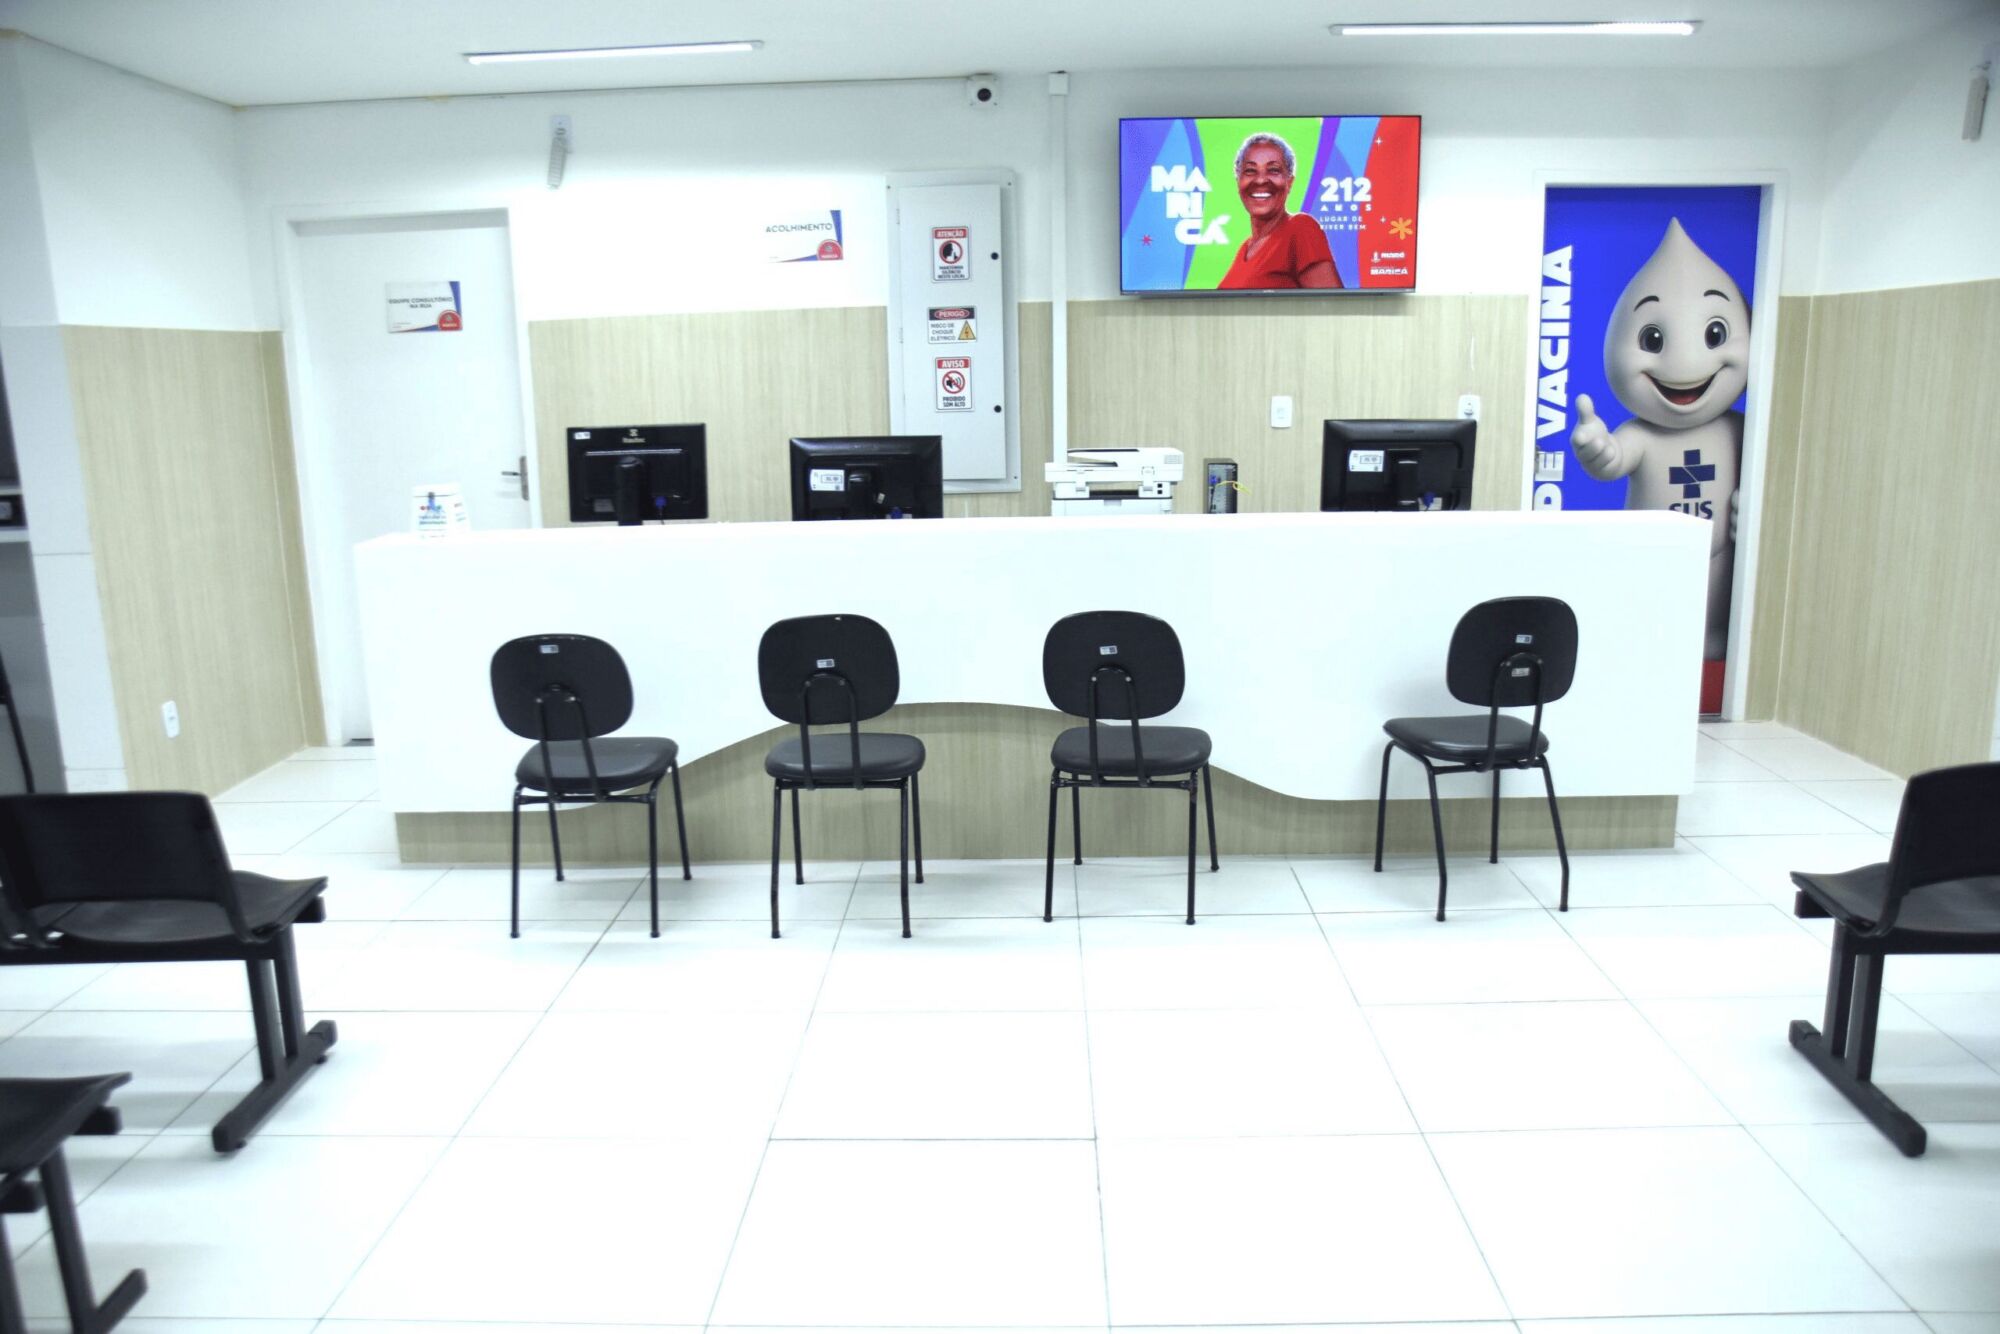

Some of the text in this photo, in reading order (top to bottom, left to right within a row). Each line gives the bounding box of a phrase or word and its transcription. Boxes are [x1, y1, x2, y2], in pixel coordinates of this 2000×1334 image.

[1151, 165, 1213, 192] MA
[1320, 177, 1372, 202] 212
[1320, 204, 1372, 212] ANOS
[765, 222, 833, 233] ACOLHIMENTO
[1174, 214, 1232, 245] CÁ
[937, 229, 964, 238] ATENÇÃO
[939, 310, 966, 318] PERIGO
[1536, 245, 1572, 440] VACINA
[943, 360, 963, 368] AVISO
